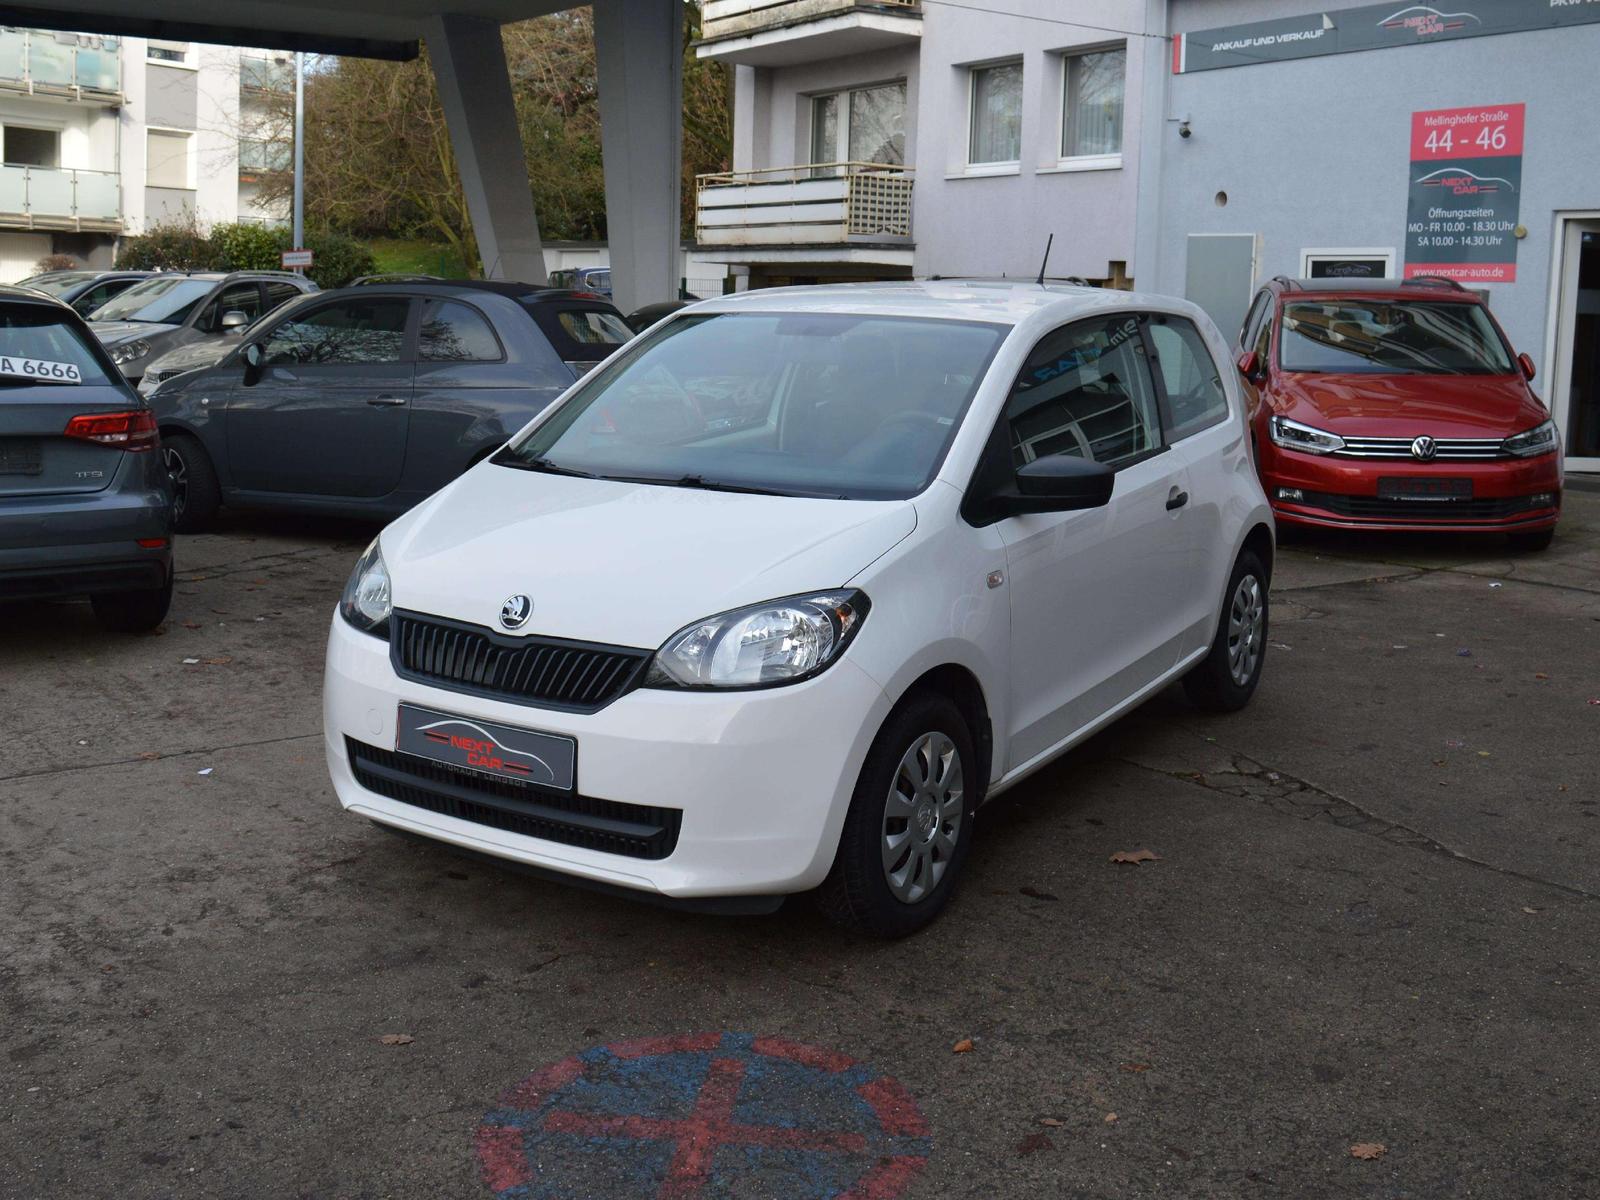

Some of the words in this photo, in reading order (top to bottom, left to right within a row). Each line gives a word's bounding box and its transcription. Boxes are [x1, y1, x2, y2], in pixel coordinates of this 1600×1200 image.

[1403, 15, 1438, 28] NEXT
[1417, 23, 1444, 35] CAR
[1211, 38, 1252, 52] ANKAUF
[1253, 36, 1275, 46] UND
[1276, 29, 1325, 43] VERKAUF
[1424, 113, 1478, 127] Mellinghofer
[1480, 110, 1509, 122] Straße
[1424, 129, 1453, 153] 44
[1475, 126, 1506, 150] 46
[1441, 177, 1473, 187] NEXT
[1453, 185, 1479, 195] CAR
[1428, 207, 1494, 220] Öffnungszeiten
[1408, 223, 1424, 233] MO
[1430, 223, 1440, 233] FR
[1443, 222, 1465, 232] 10.00
[1472, 221, 1496, 231] 18.30
[1497, 221, 1514, 231] Uhr
[1418, 236, 1429, 246] SA
[1431, 236, 1454, 246] 10.00
[1461, 236, 1484, 246] 14.30
[1485, 236, 1502, 246] Uhr
[1413, 267, 1504, 278] www.nextcar-auto.de
[23, 360, 78, 380] 6666
[451, 735, 496, 754] NEXT
[468, 752, 503, 769] CAR
